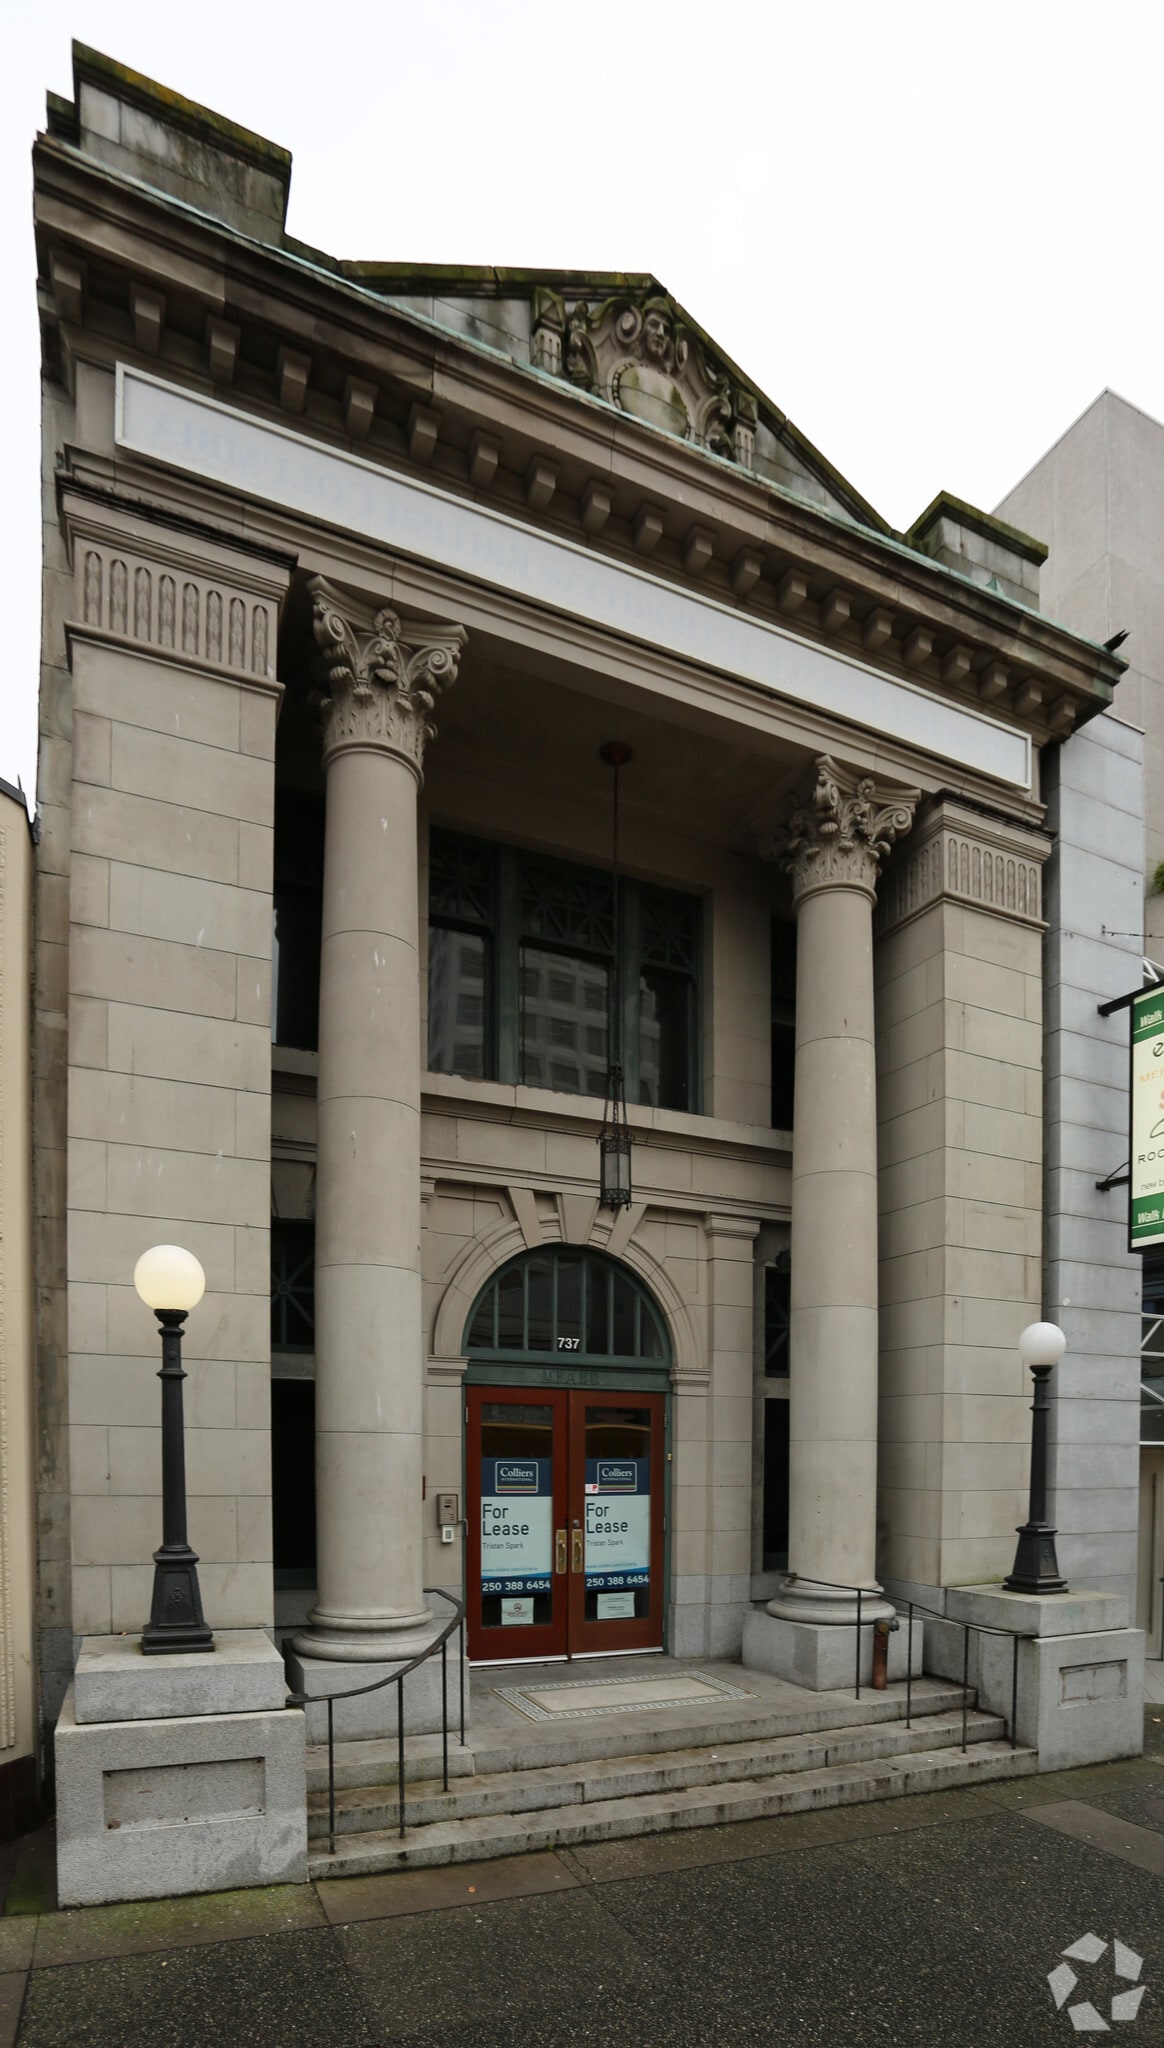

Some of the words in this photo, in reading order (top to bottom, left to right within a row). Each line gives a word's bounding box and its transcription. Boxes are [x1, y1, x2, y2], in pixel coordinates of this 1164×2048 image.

[557, 1337, 580, 1349] 737
[500, 1467, 534, 1477] Colliers
[601, 1467, 632, 1477] Colliers
[482, 1503, 509, 1519] For
[586, 1502, 610, 1517] For
[482, 1520, 530, 1536] Lease
[586, 1519, 628, 1534] Lease
[482, 1542, 504, 1550] Tristan
[482, 1582, 502, 1592] 250
[505, 1581, 523, 1591] 388
[526, 1580, 551, 1590] 6454
[586, 1578, 605, 1587] 250
[607, 1576, 624, 1586] 388
[626, 1574, 649, 1584] 6454
